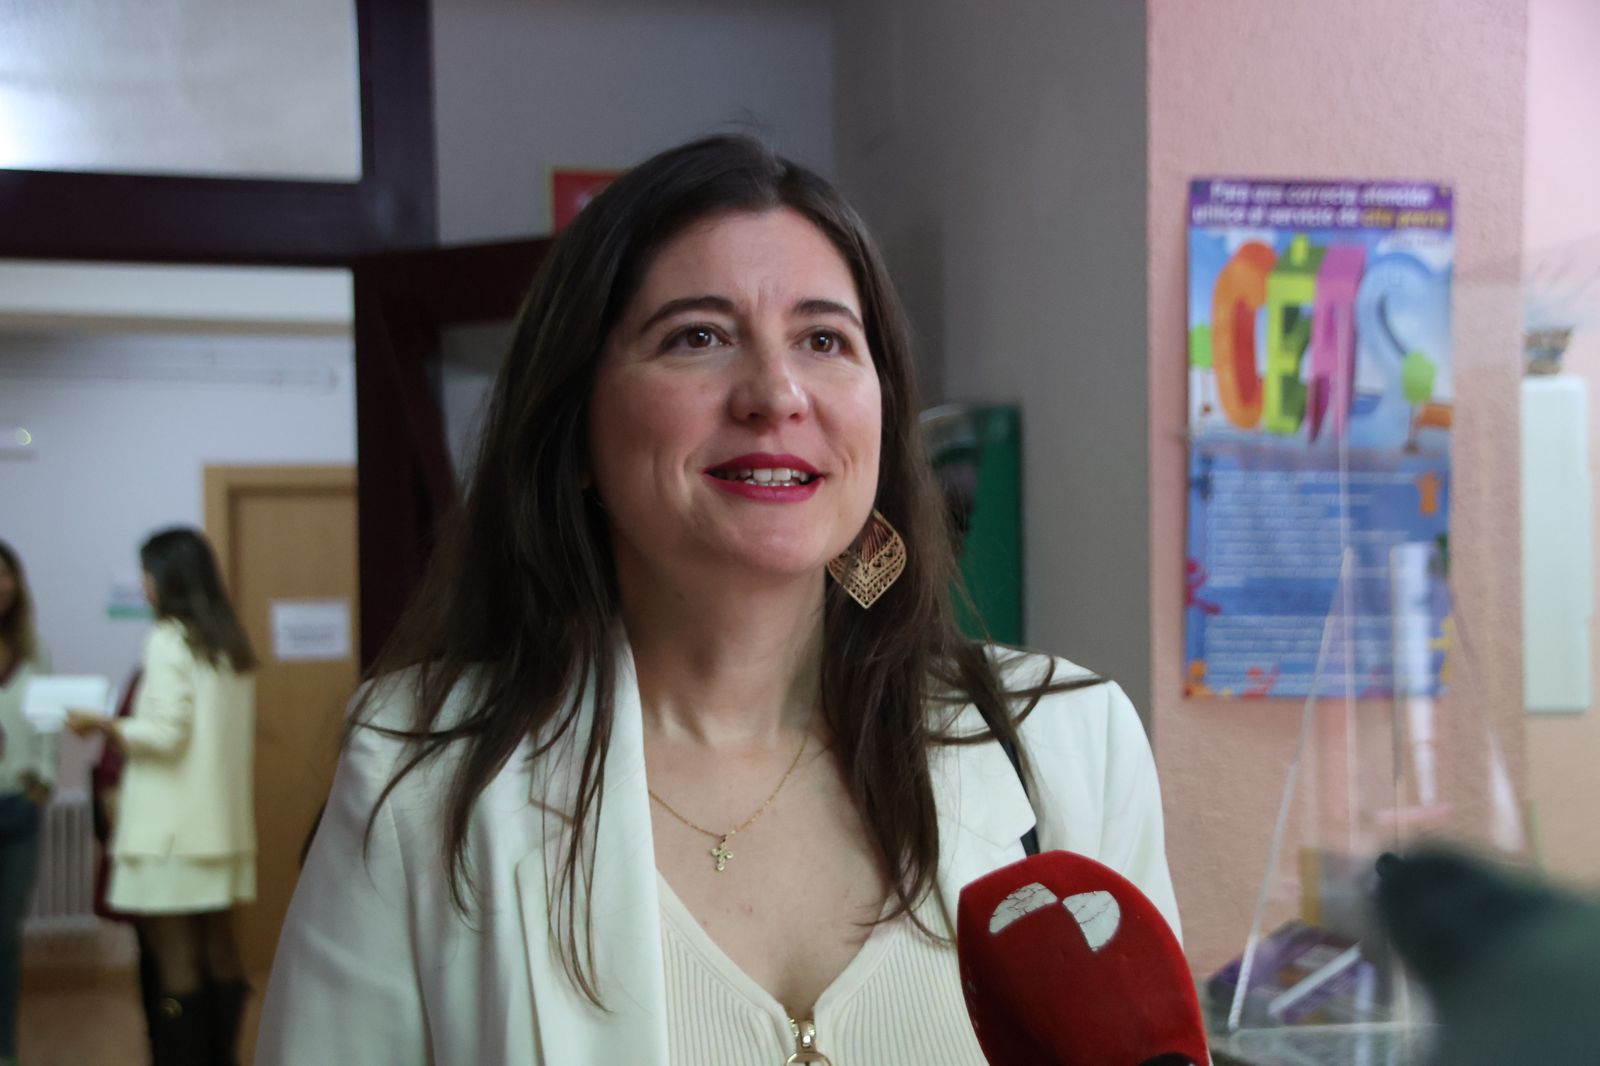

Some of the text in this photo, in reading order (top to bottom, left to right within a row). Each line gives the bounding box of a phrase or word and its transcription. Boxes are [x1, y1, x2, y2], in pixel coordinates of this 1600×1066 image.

[1210, 182, 1249, 202] Para
[1252, 185, 1283, 203] una
[1267, 206, 1333, 226] servicio
